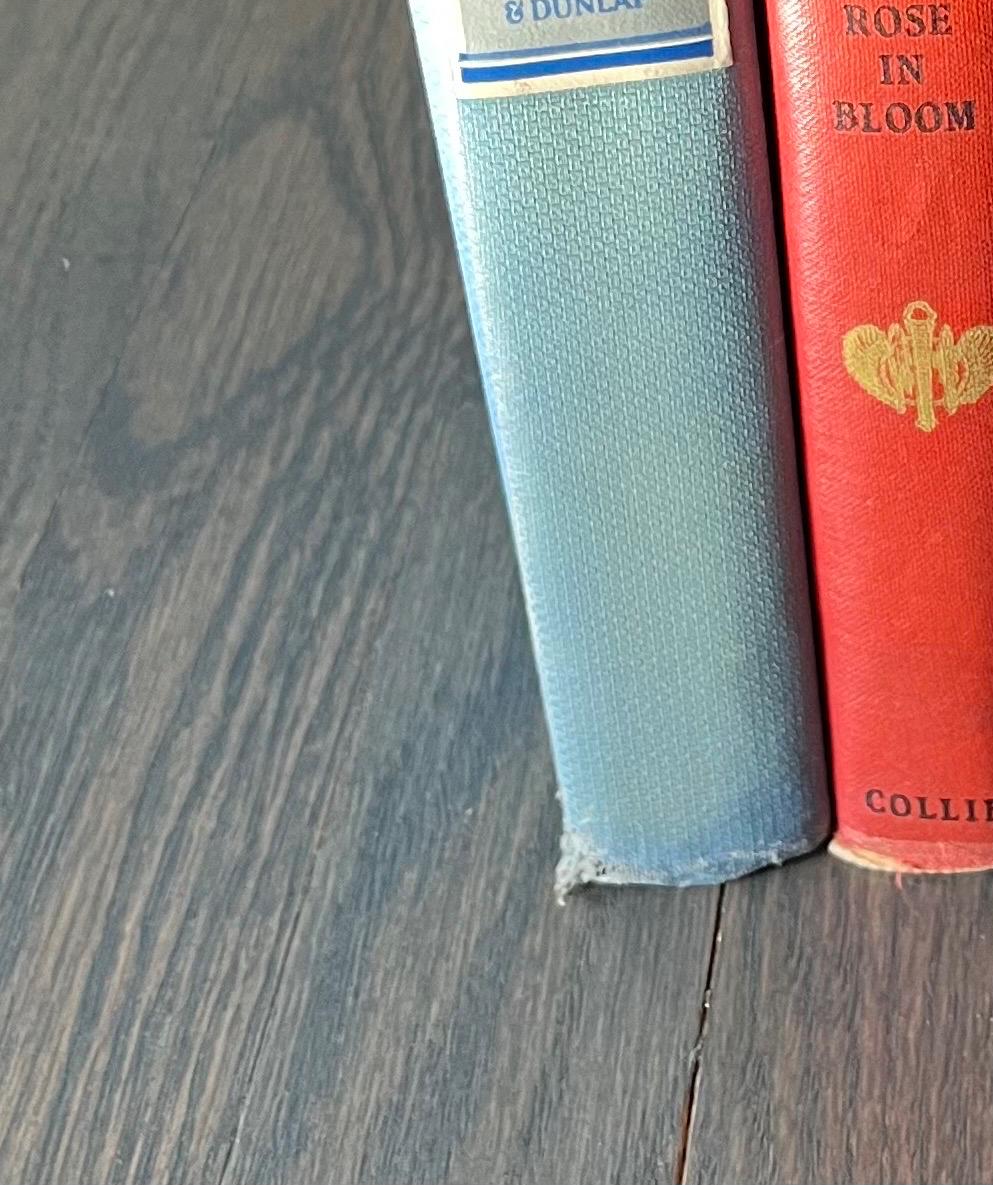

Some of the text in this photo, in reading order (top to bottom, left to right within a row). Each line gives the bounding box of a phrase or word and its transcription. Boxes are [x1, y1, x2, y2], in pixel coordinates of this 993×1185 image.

[505, 0, 524, 24] &
[843, 3, 953, 38] ROSE
[879, 54, 924, 85] IN
[832, 100, 977, 134] BLOOM
